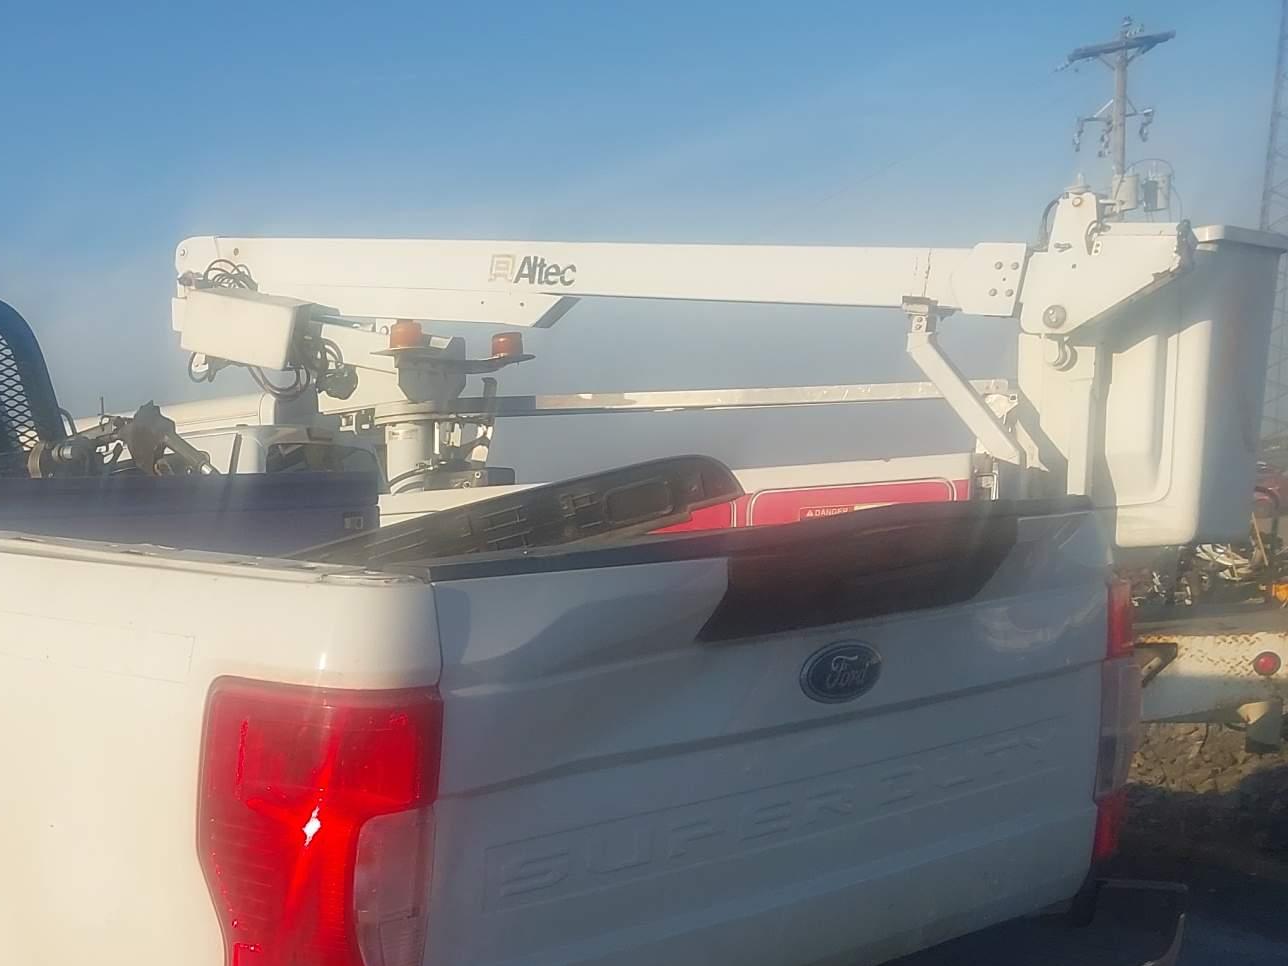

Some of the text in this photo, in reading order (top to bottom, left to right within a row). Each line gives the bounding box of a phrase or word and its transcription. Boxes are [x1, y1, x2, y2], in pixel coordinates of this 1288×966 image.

[513, 256, 576, 286] Altec
[825, 654, 870, 689] Ford
[499, 784, 857, 897] SUPER
